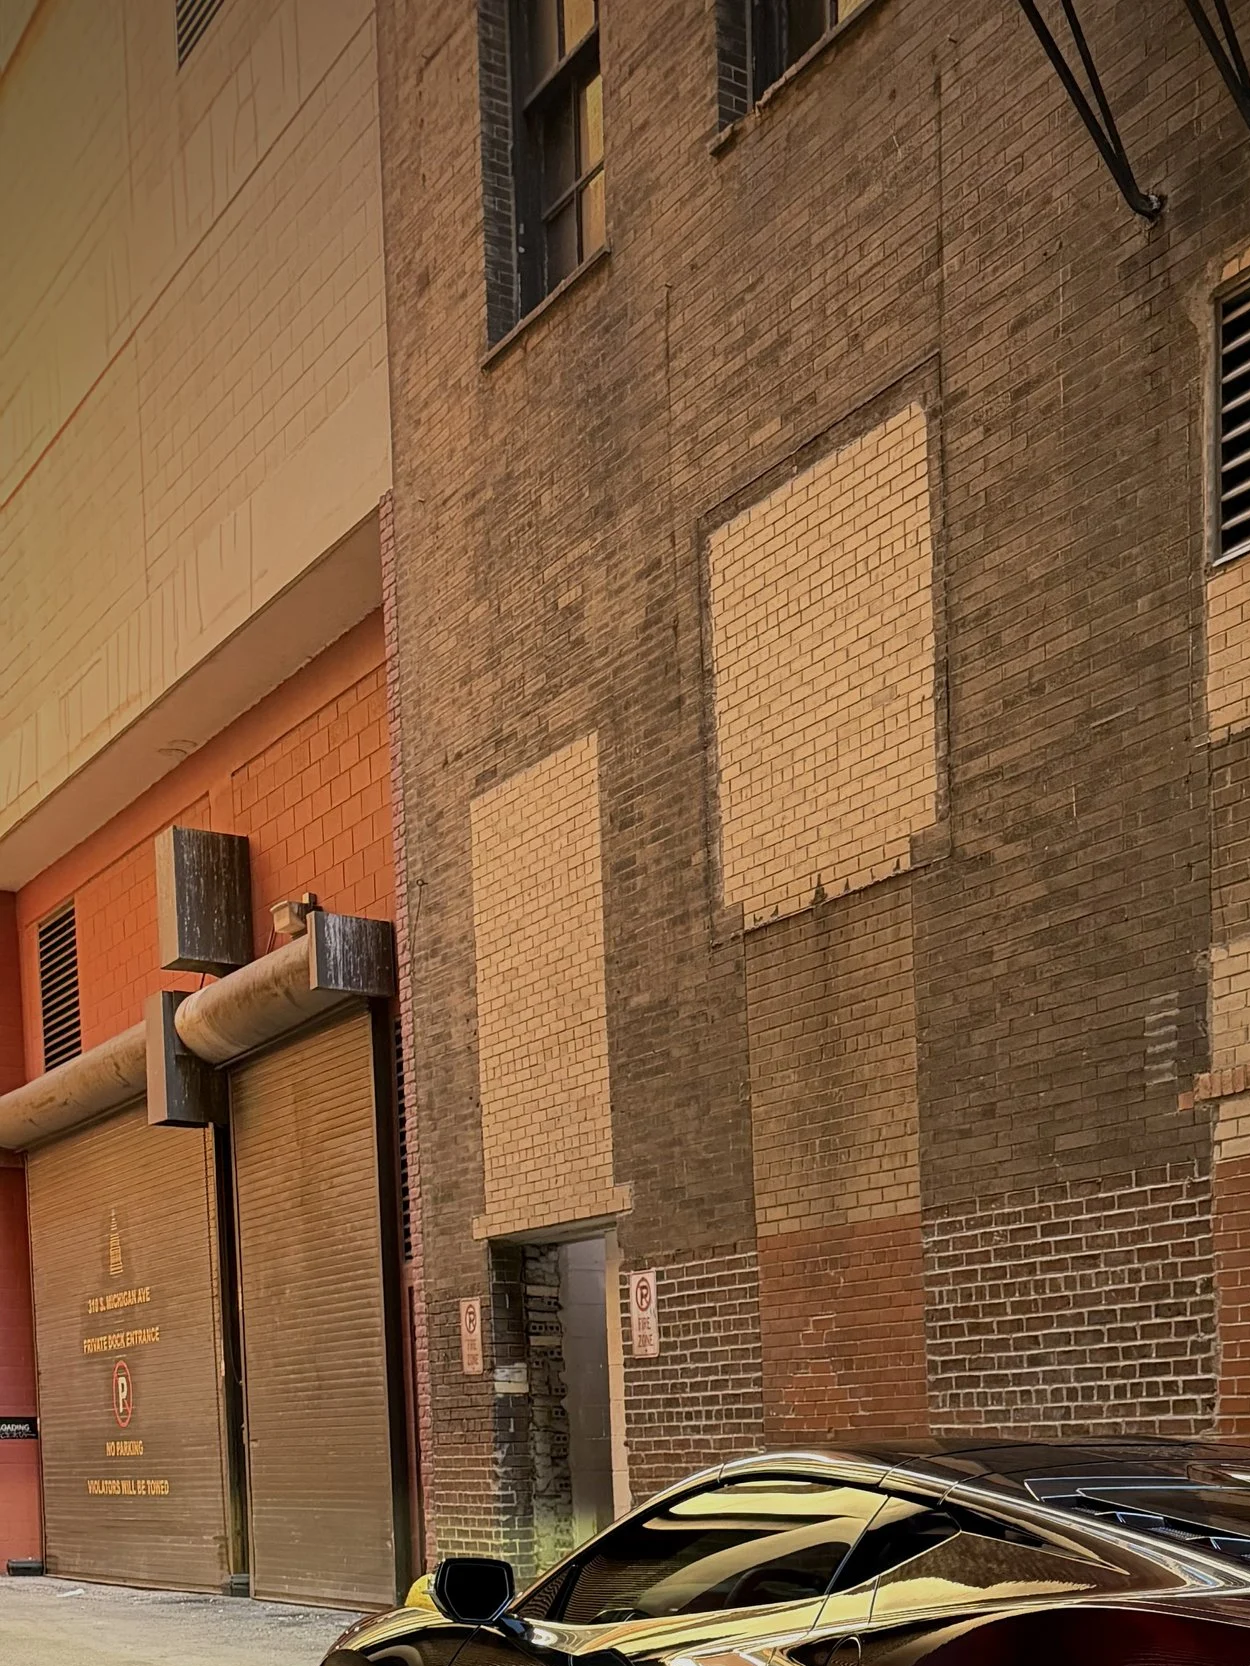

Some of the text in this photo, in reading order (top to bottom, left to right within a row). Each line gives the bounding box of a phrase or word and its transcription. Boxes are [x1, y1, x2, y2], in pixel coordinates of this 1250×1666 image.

[106, 1289, 137, 1310] MICHIGAN
[126, 1326, 160, 1347] ENTRANCE
[106, 1439, 144, 1456] NO PARKING
[87, 1479, 169, 1495] VIOLATORS WILL BE TOWED
